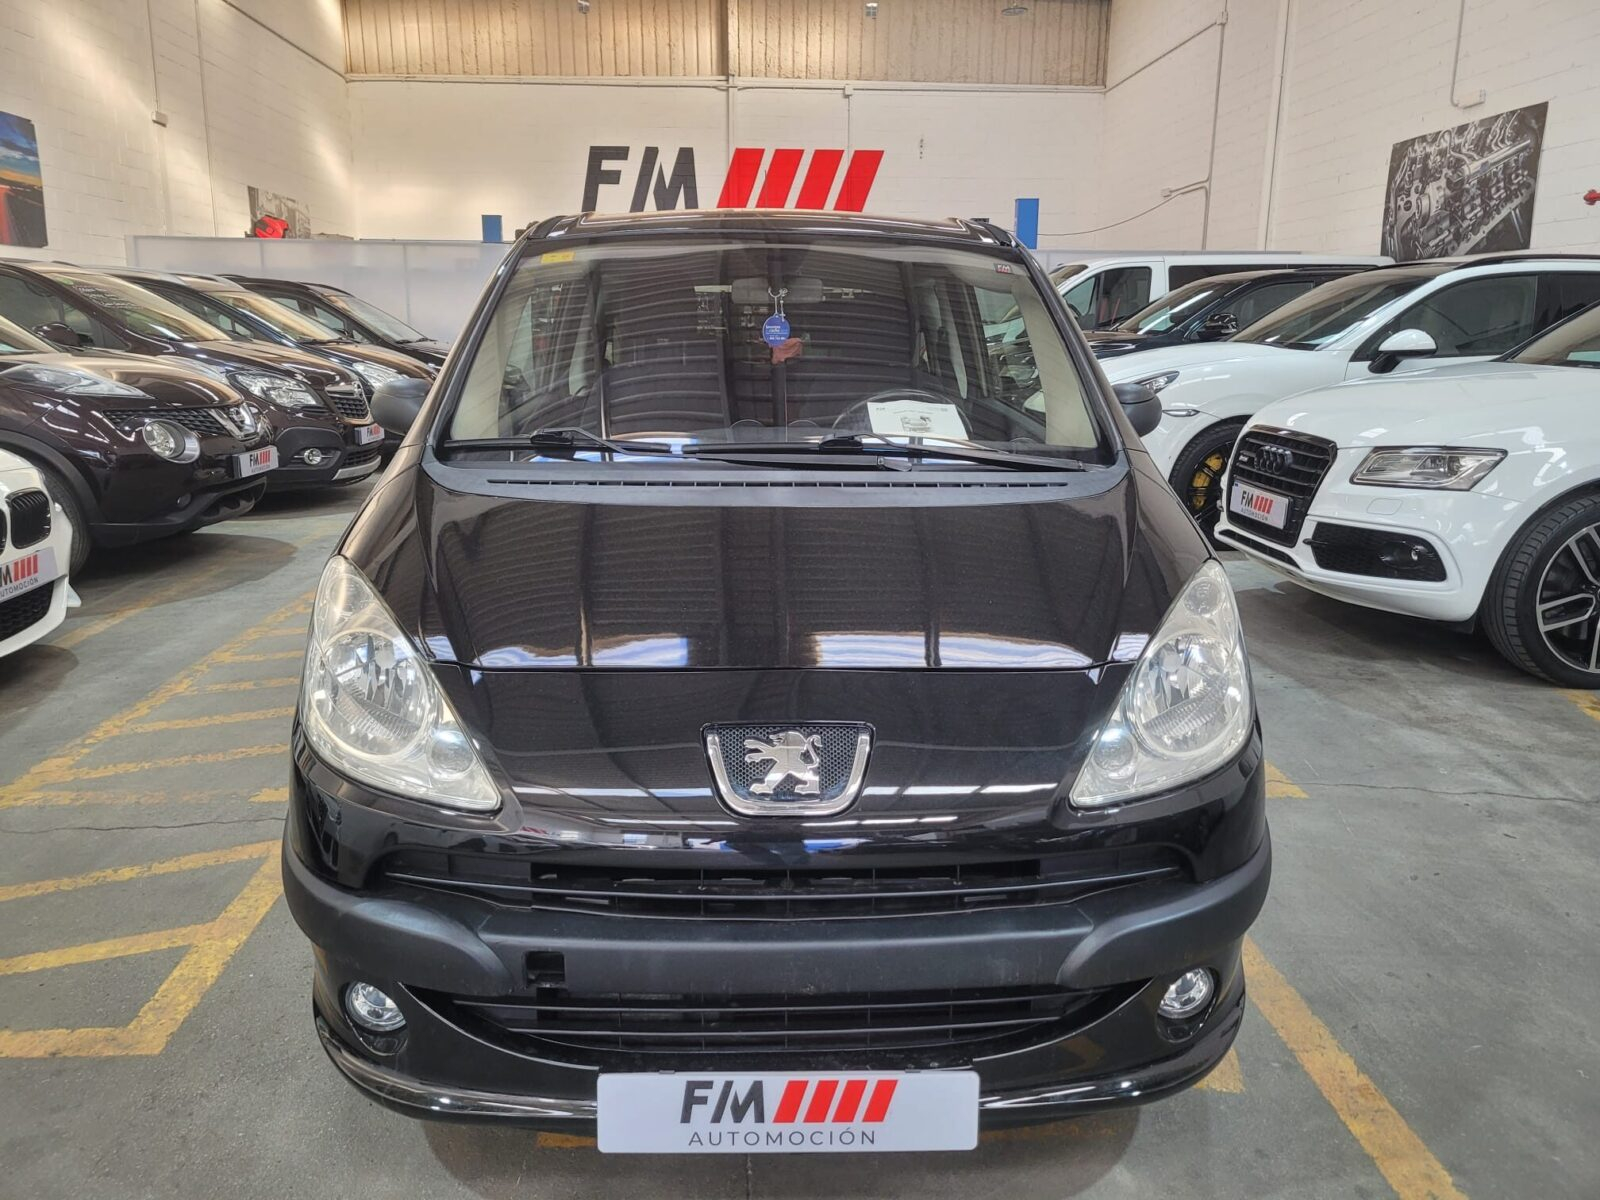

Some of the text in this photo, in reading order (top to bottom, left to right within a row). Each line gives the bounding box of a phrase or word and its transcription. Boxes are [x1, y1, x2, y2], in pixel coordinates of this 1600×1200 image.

[581, 146, 699, 213] FM
[1240, 490, 1254, 509] FM
[0, 564, 13, 587] M
[0, 576, 39, 598] UTOMOCIÓN
[680, 1080, 765, 1124] FM
[688, 1127, 876, 1147] AUTOMOCIÓN
